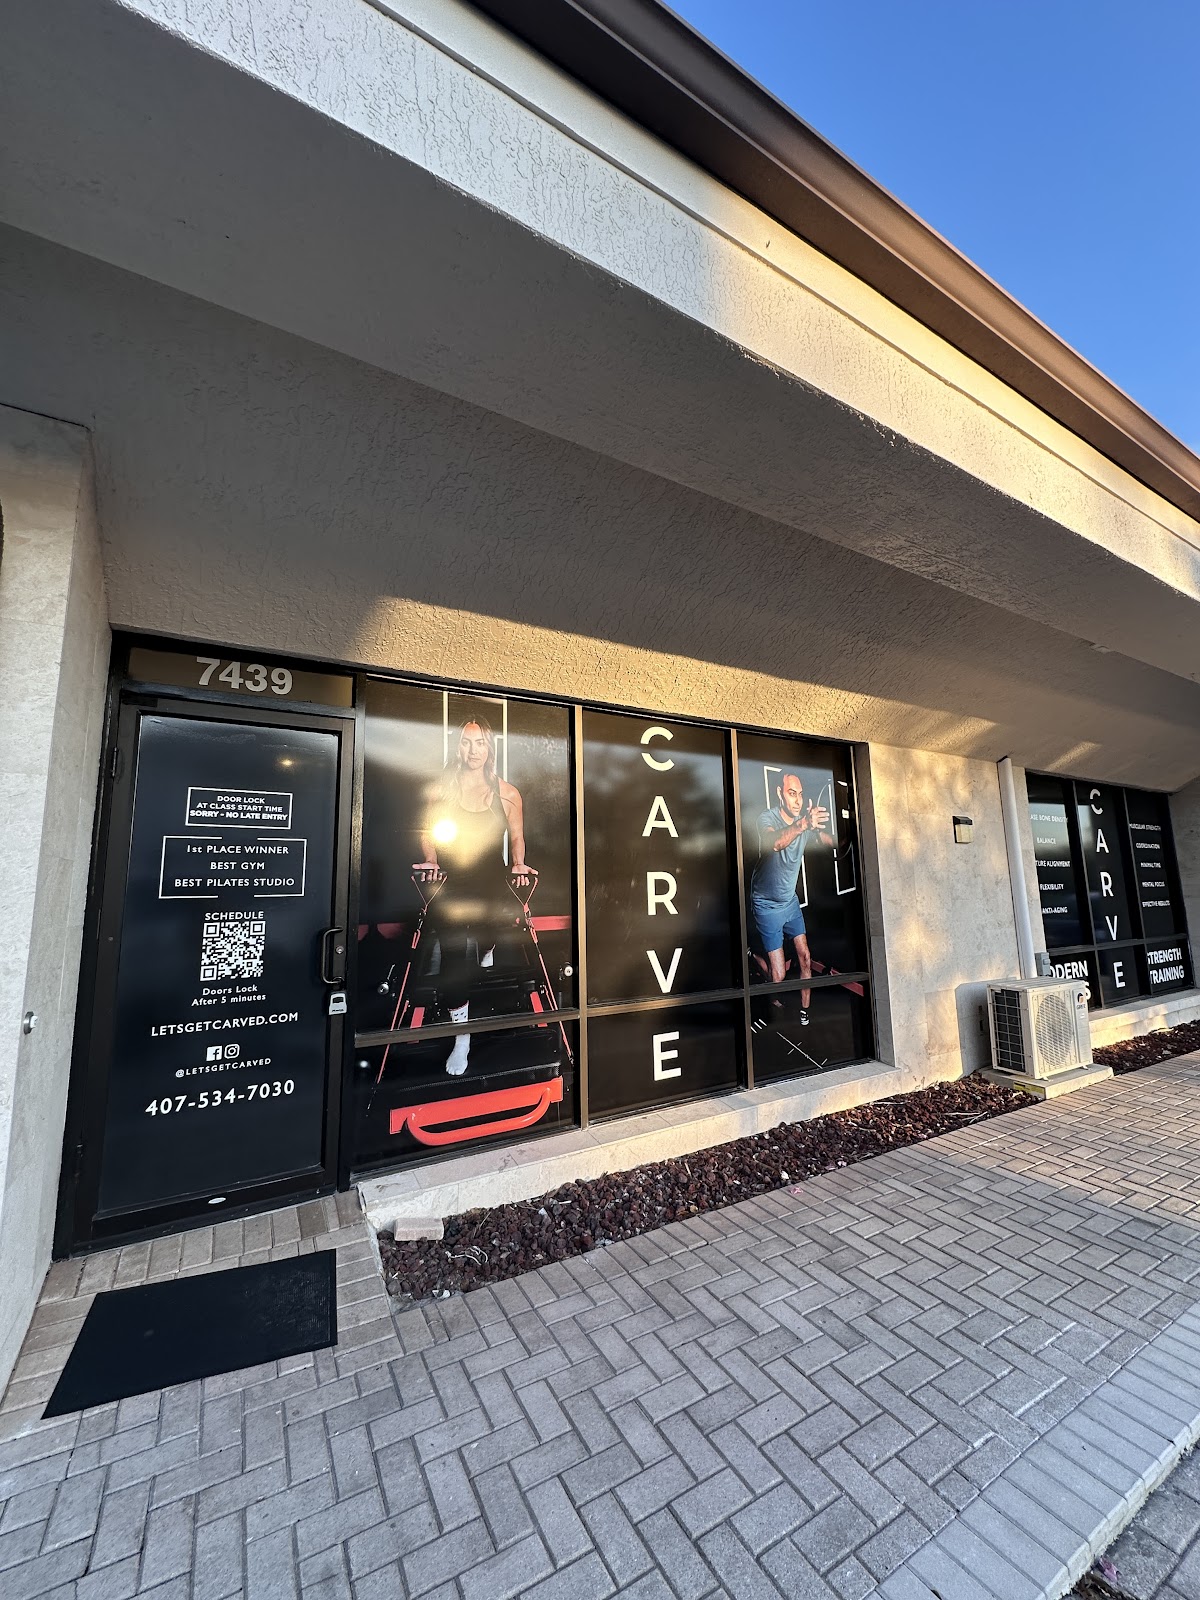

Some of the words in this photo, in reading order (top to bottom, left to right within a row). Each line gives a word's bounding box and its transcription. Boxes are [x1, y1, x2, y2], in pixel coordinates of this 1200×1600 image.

[197, 656, 293, 695] 7439
[217, 795, 242, 803] DOOR
[243, 796, 266, 804] LOCK
[189, 809, 220, 818] SORRY
[225, 811, 240, 819] NO
[240, 812, 261, 820] LATE
[261, 813, 288, 821] ENTRY
[237, 804, 263, 812] START
[264, 805, 283, 813] TIME
[186, 844, 203, 854] 1st
[206, 844, 242, 854] PLACE
[244, 844, 289, 855] WINNER
[210, 861, 237, 870] BEST
[240, 861, 265, 870] GYM
[174, 878, 203, 888] BEST
[206, 878, 250, 887] PILATES
[253, 877, 295, 887] STUDIO
[1090, 788, 1126, 989] CARVE
[640, 726, 683, 1082] CARVE
[204, 910, 265, 921] SCHEDULE
[1050, 960, 1089, 979] ODERN
[1150, 964, 1184, 984] TRAINING
[202, 987, 233, 996] Doors
[235, 984, 258, 993] Lock
[191, 997, 218, 1007] After
[220, 995, 227, 1004] 5
[230, 994, 267, 1003] minutes
[151, 1011, 298, 1037] LETSGETCARVED.COM
[175, 1057, 272, 1078] @LETSGETCARVED
[145, 1079, 295, 1116] 407-534-7030
